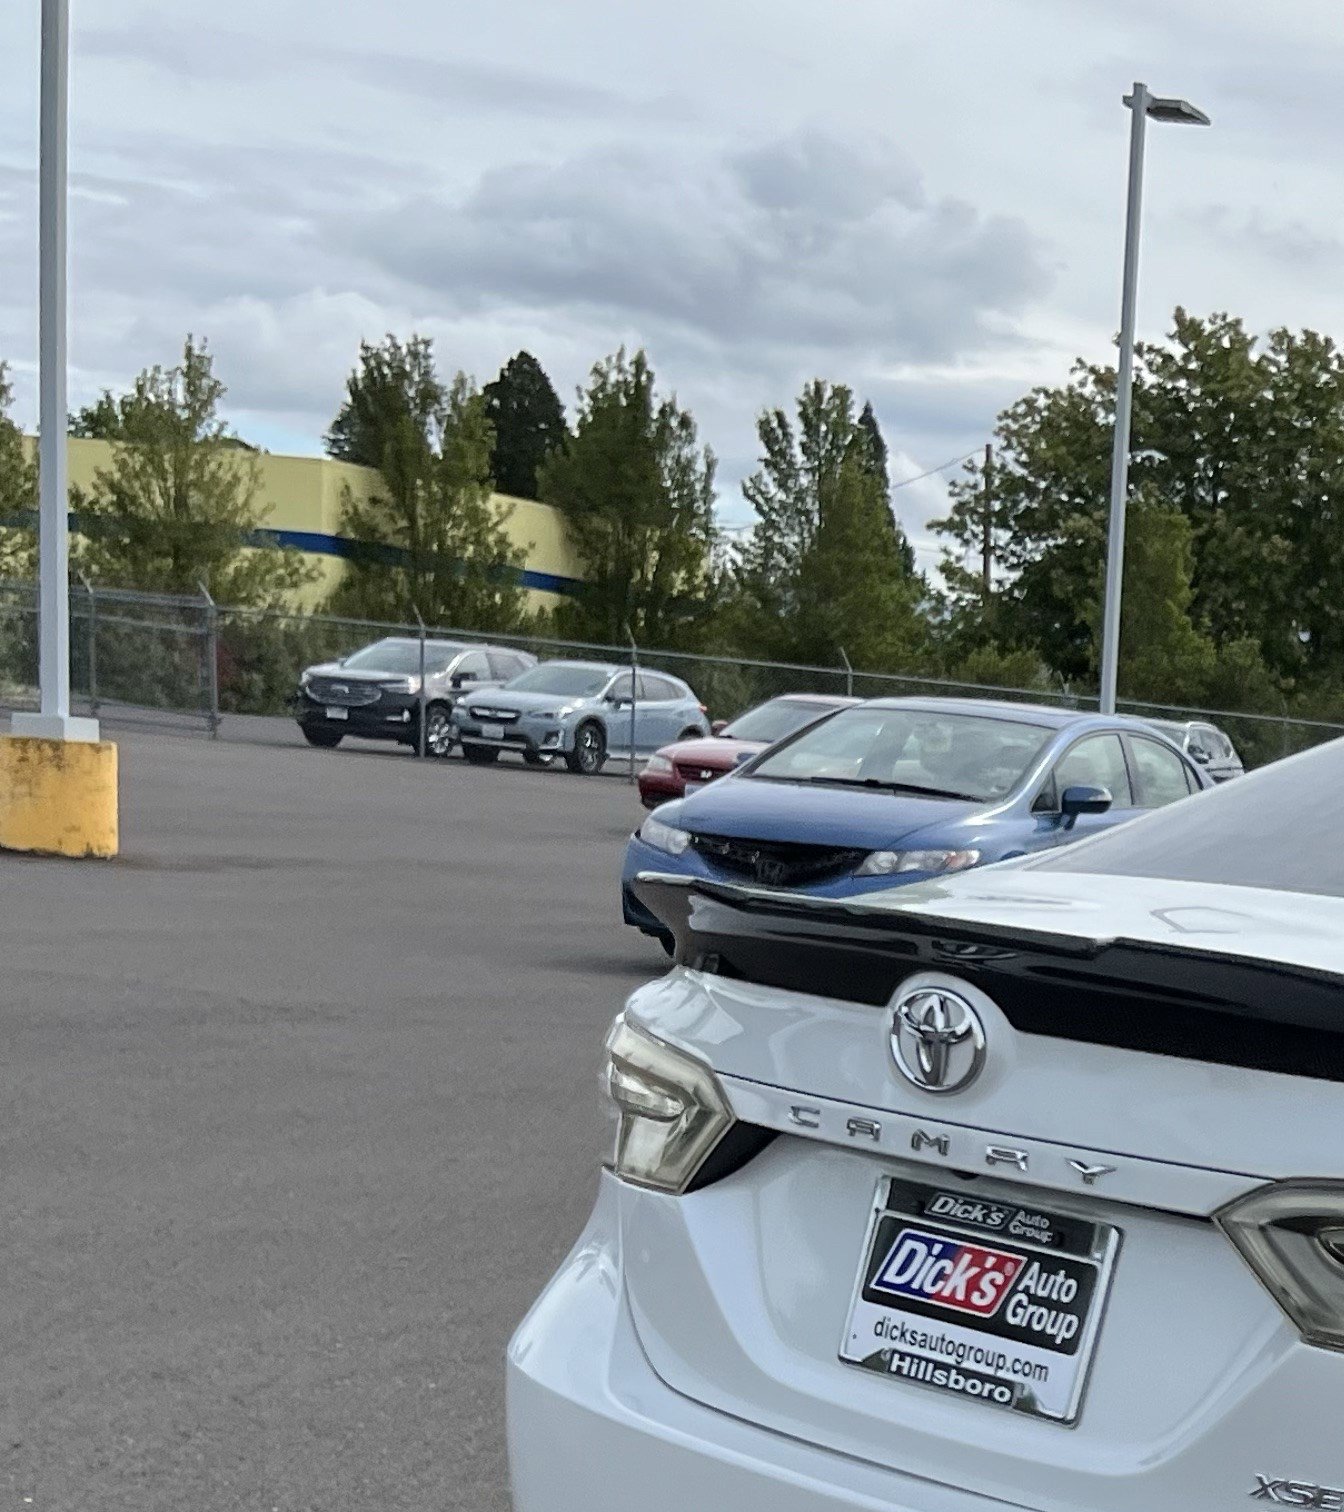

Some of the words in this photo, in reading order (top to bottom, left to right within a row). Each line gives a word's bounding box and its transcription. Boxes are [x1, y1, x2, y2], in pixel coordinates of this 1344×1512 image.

[787, 1105, 1118, 1185] CAMRY
[931, 1196, 1006, 1227] Dick's
[1016, 1211, 1050, 1229] Auto
[883, 1240, 1005, 1307] Dick's
[1018, 1262, 1078, 1303] Auto
[1006, 1294, 1079, 1344] Group
[874, 1316, 1050, 1383] dicksautogroup.com
[890, 1353, 1012, 1403] Hillsboro
